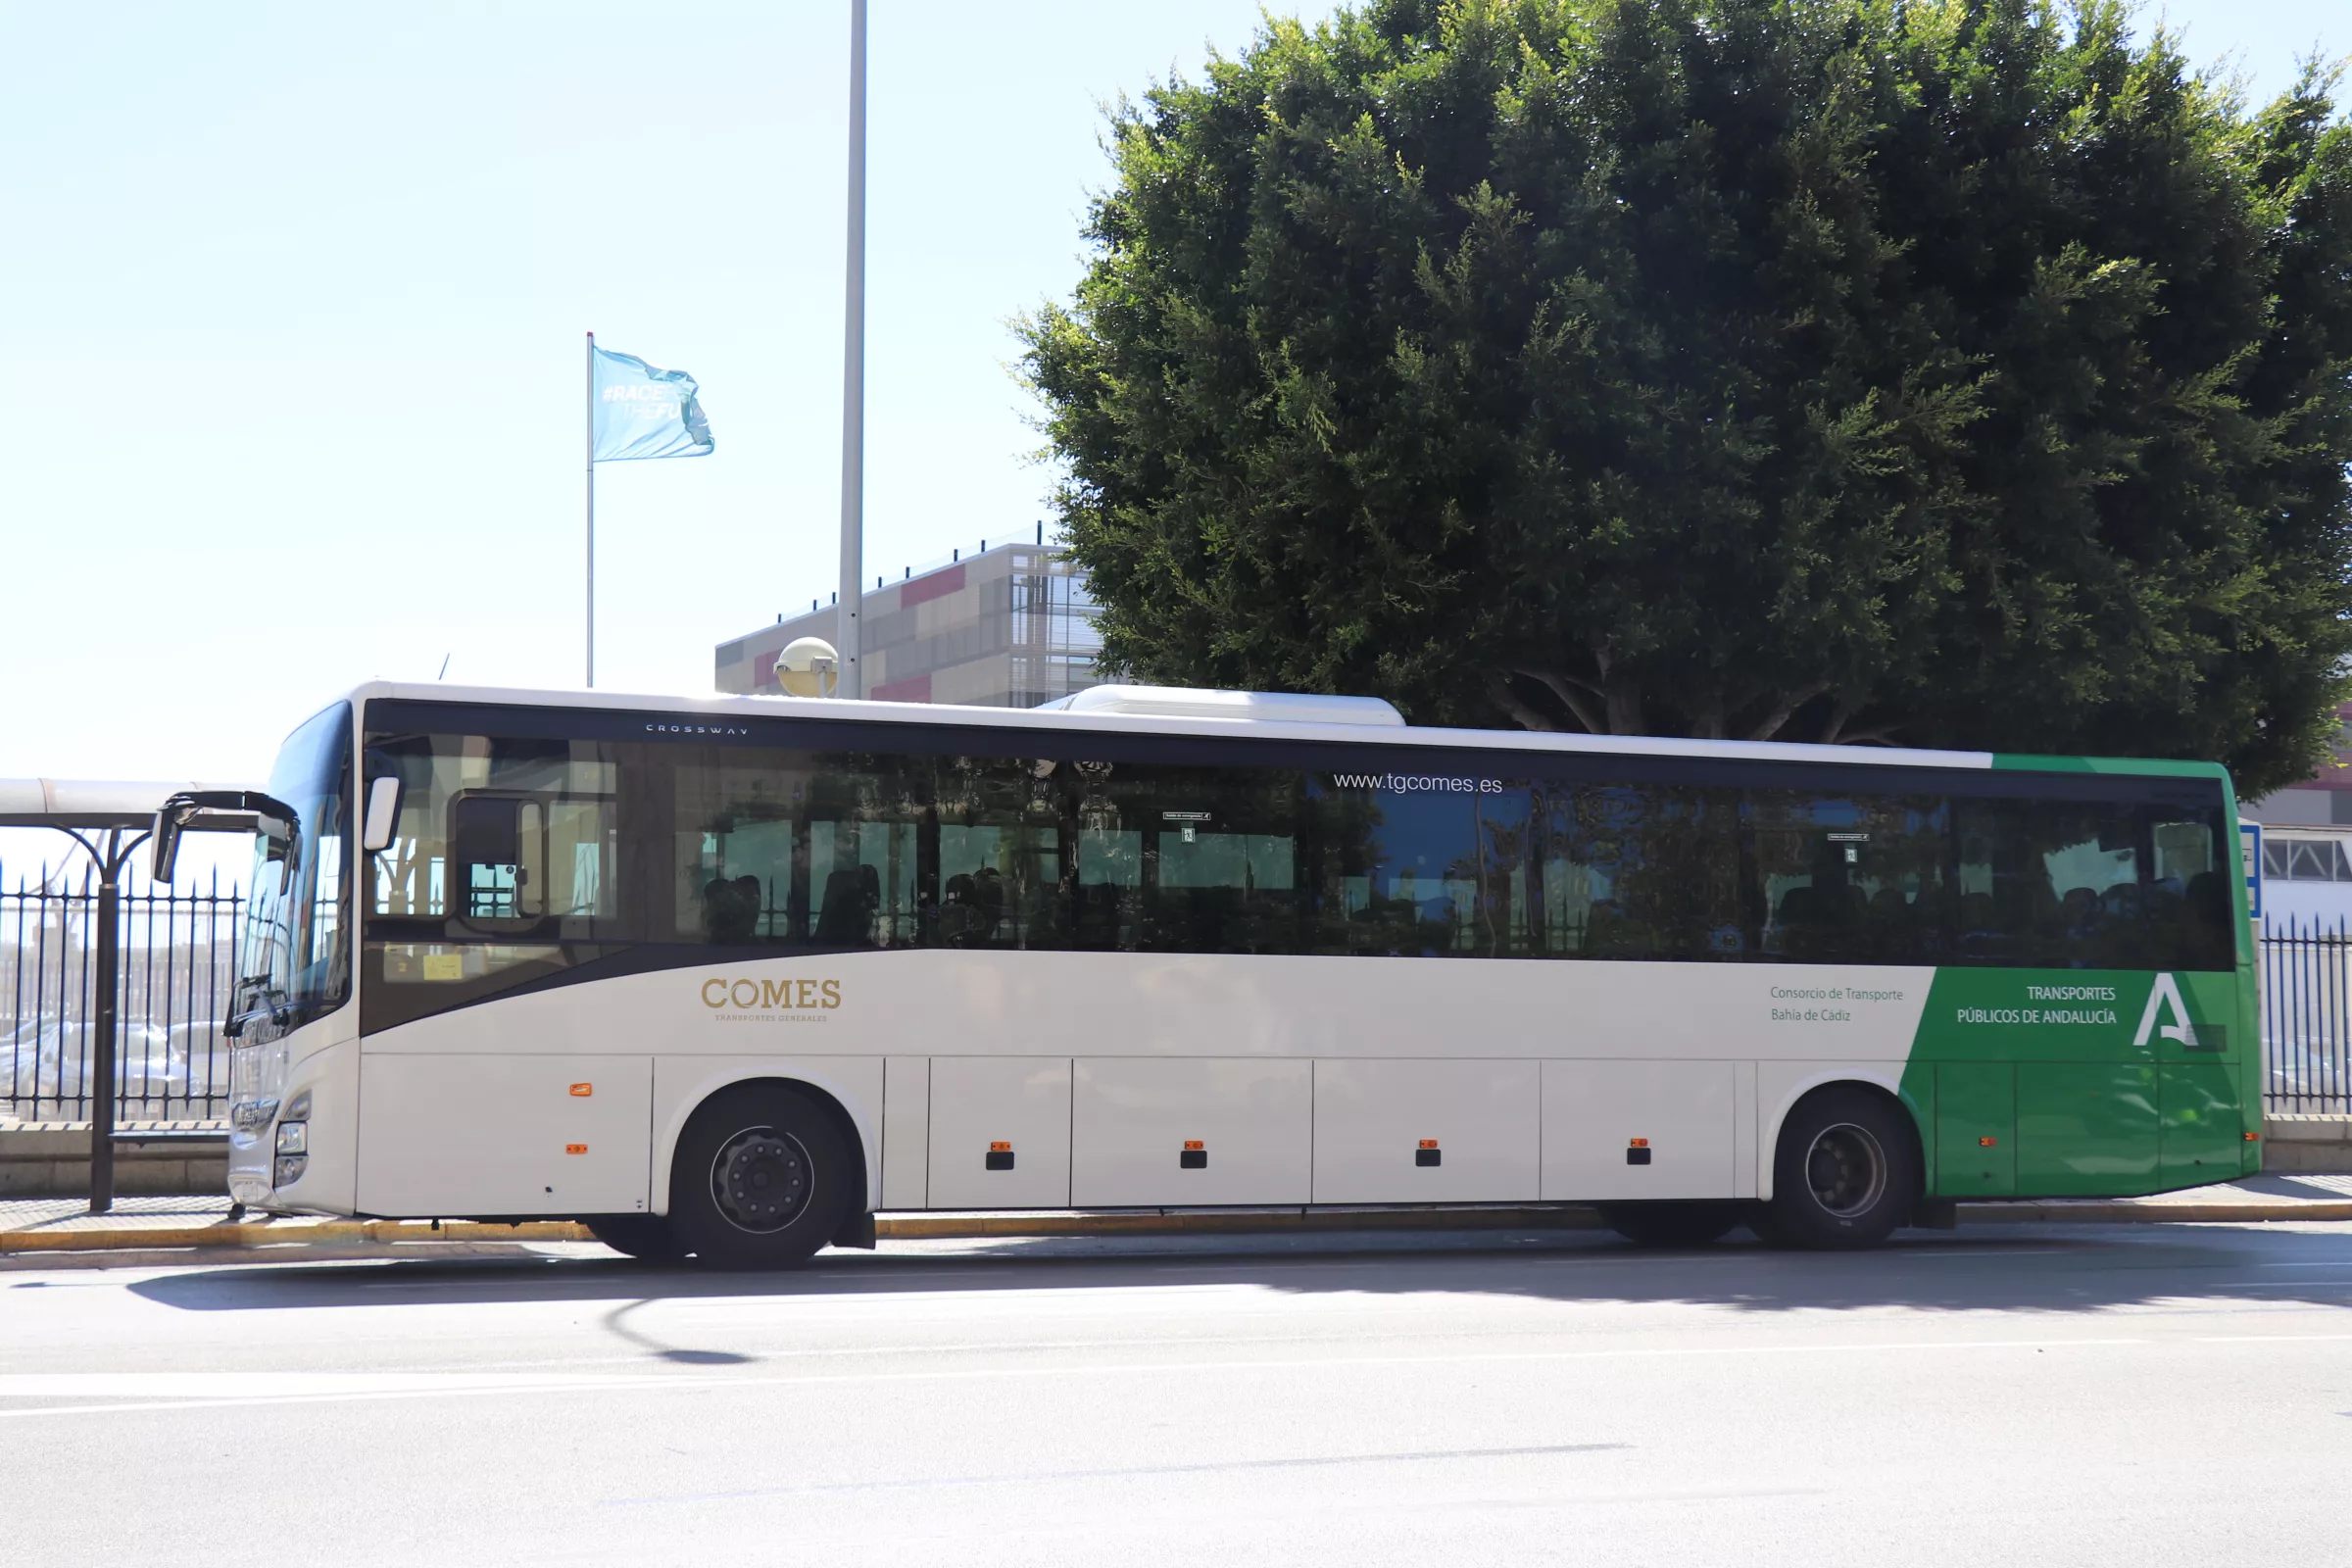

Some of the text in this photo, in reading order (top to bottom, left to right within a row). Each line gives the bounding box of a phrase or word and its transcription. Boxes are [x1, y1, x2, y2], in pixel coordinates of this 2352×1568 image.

[1334, 773, 1503, 794] www.tgcomes.es
[702, 979, 841, 1008] COMES
[1770, 987, 1903, 1003] Consorcio de Transporte
[2027, 986, 2116, 1001] TRANSPORTES
[1771, 1008, 1851, 1021] Bahía de Cádiz
[1957, 1006, 2117, 1024] PÚBLICOS DE ANDALUCÍA
